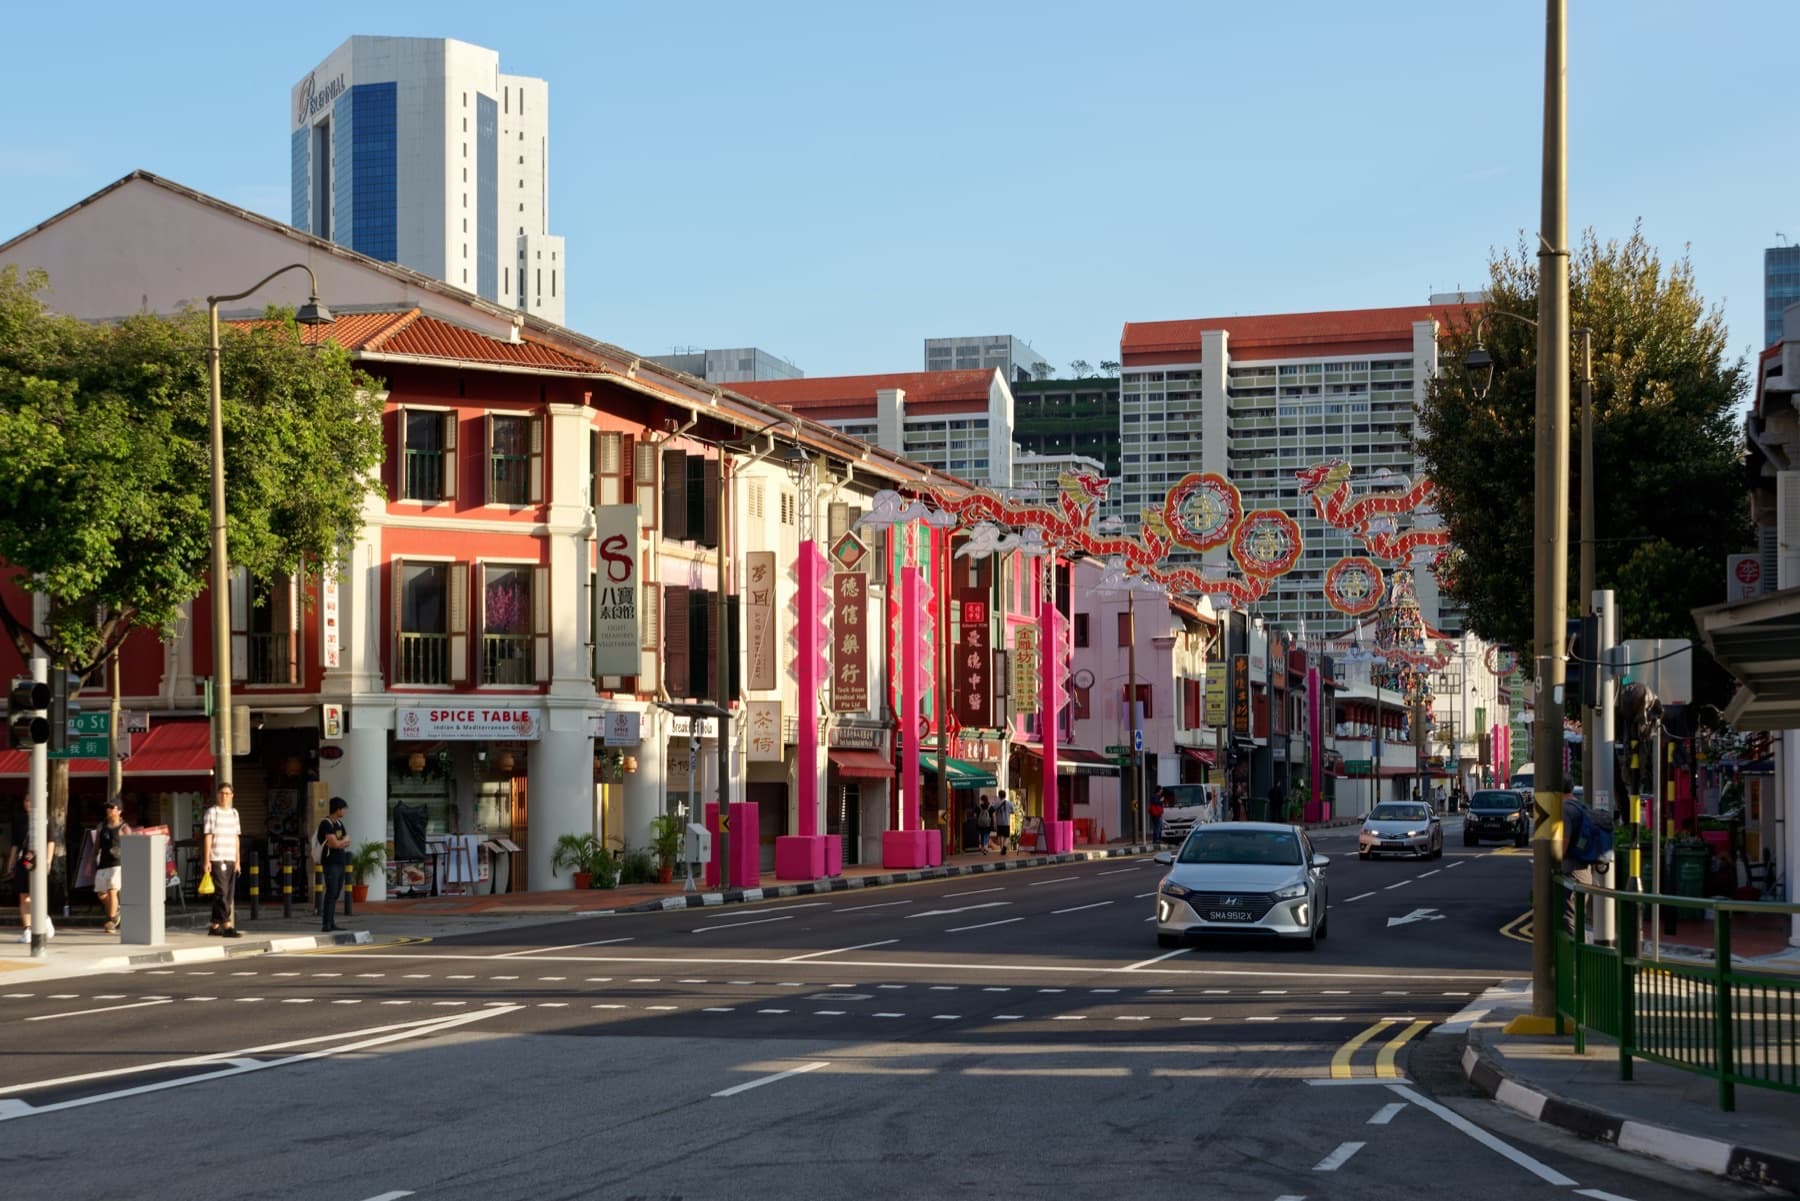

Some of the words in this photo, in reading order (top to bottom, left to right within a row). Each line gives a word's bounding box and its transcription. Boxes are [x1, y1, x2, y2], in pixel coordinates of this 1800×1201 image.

[90, 715, 105, 729] St
[430, 710, 475, 722] SPICE
[482, 710, 529, 722] TABLE
